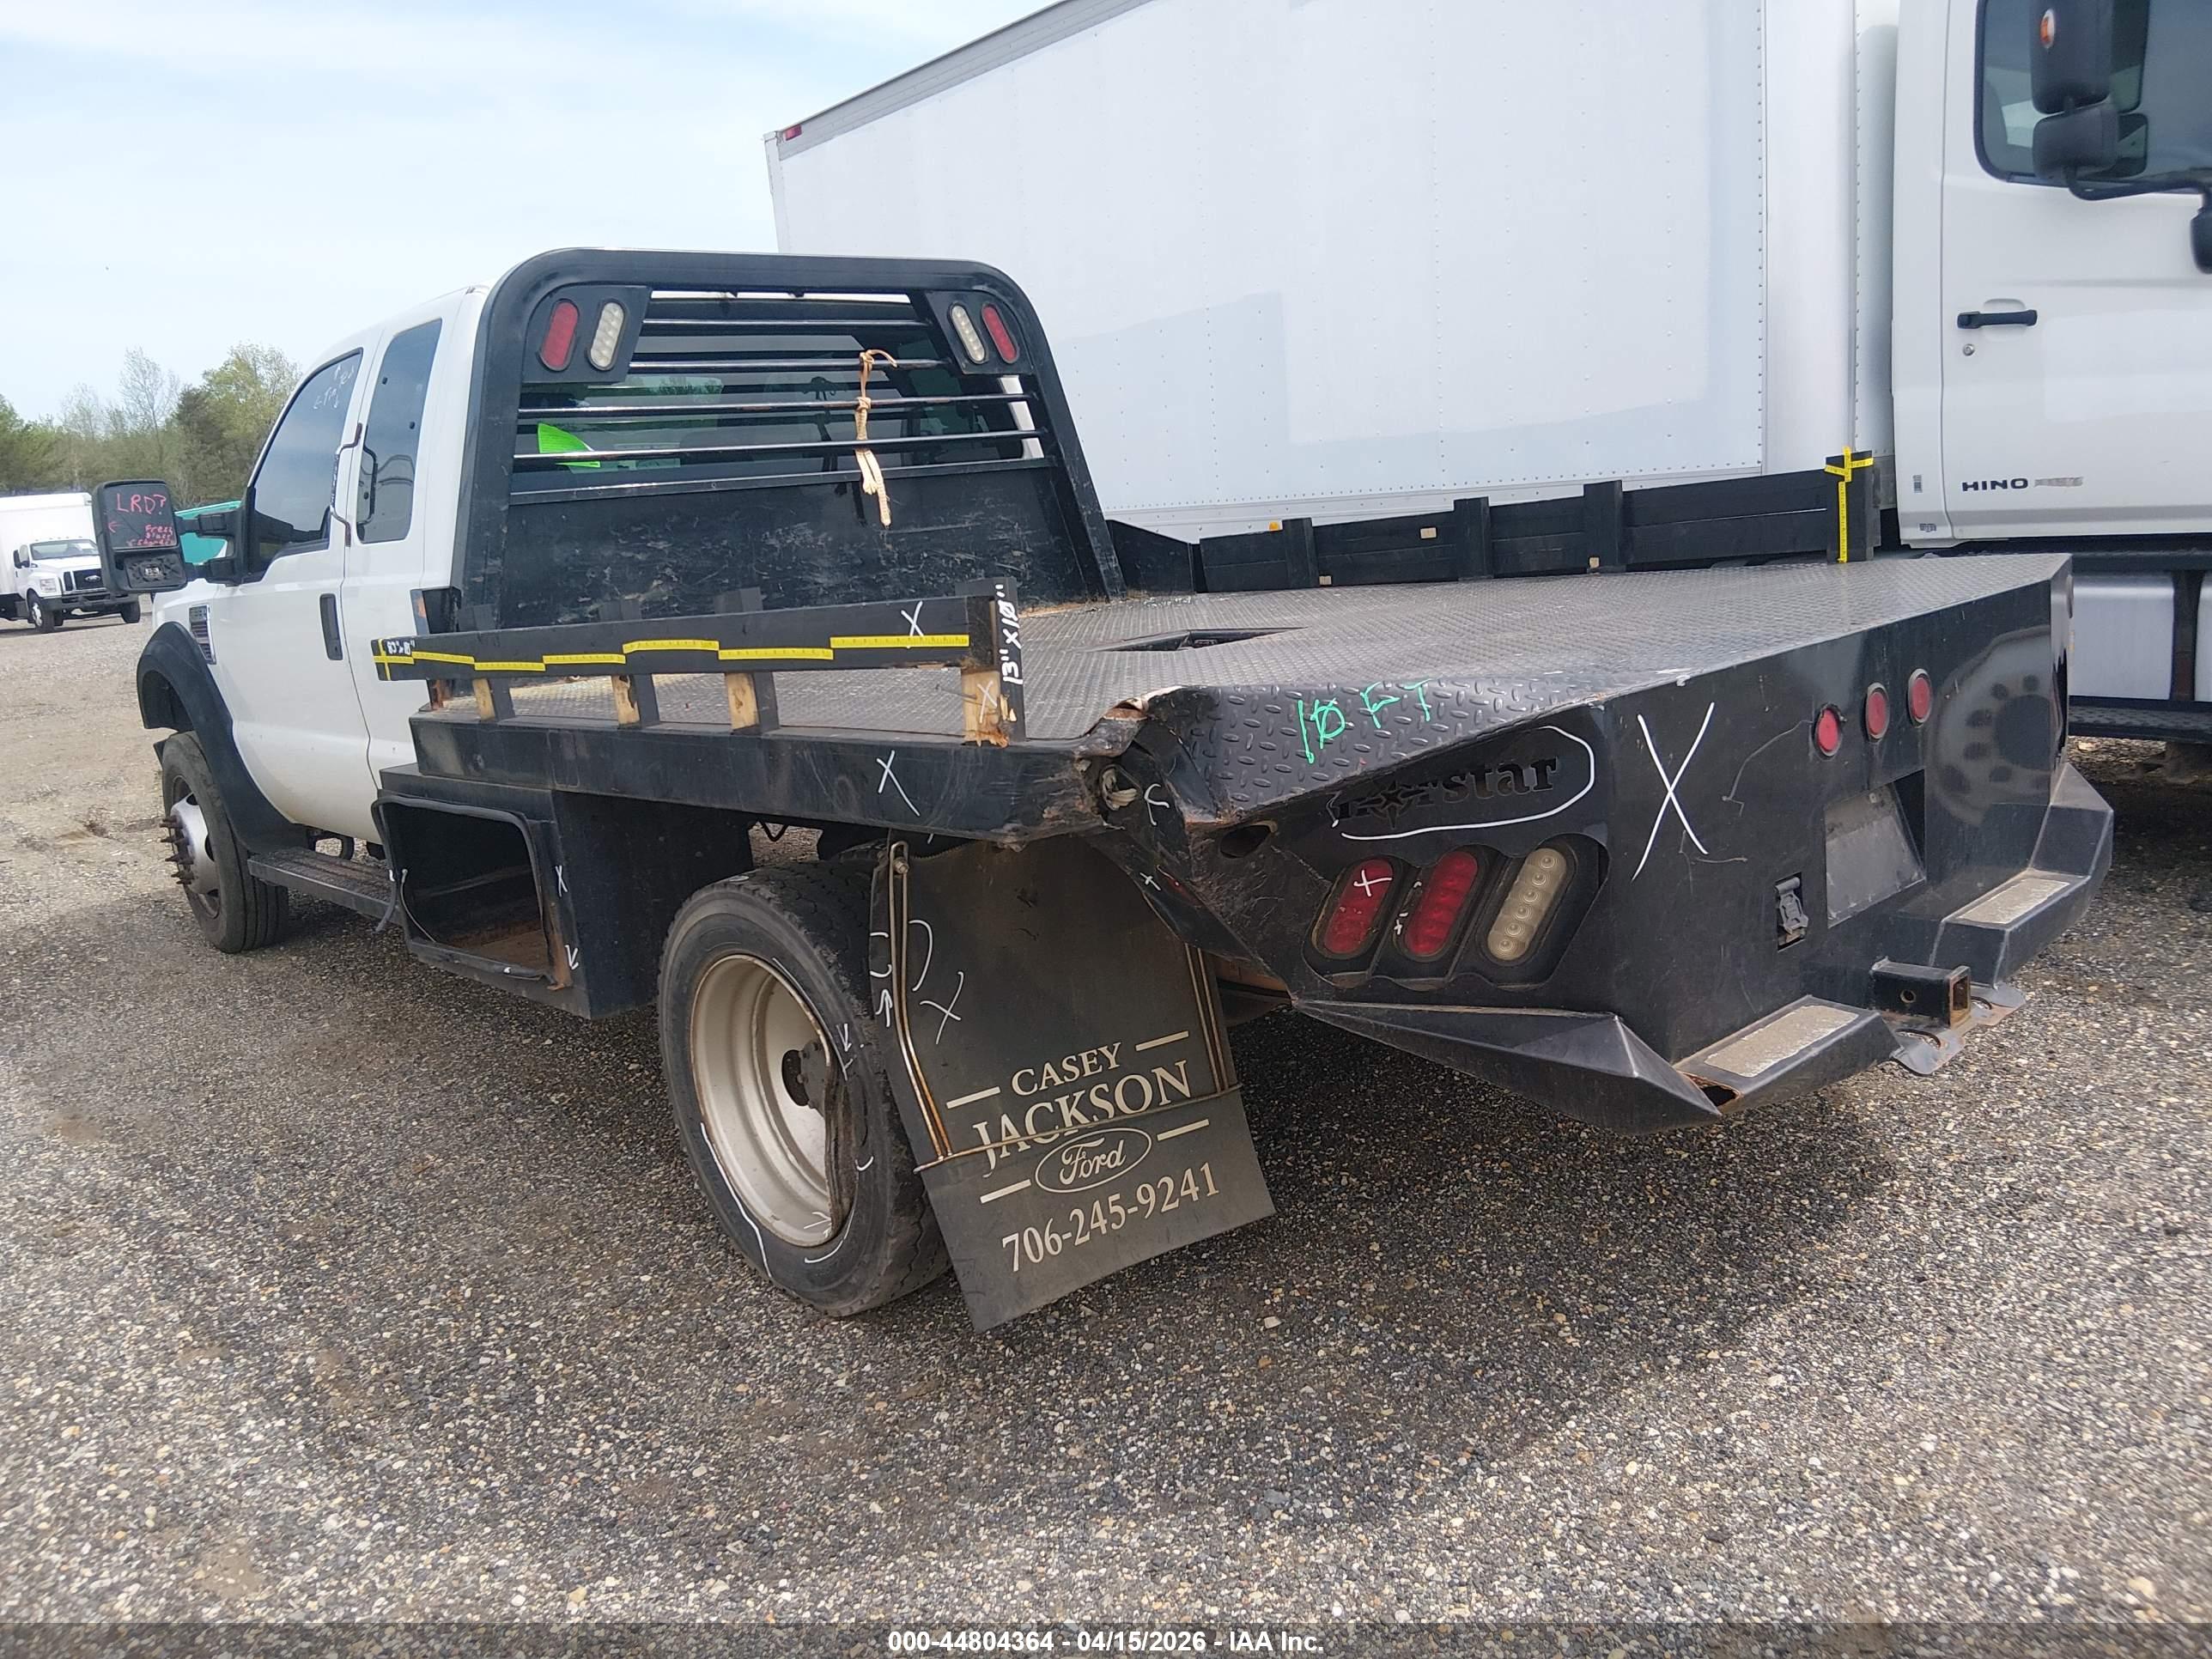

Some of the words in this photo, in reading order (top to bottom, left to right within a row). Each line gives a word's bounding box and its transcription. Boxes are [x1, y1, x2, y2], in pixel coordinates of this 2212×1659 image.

[1962, 477, 2028, 491] HINO
[1012, 1042, 1121, 1097] CASEY
[973, 1060, 1191, 1177] JACKSON
[1059, 1137, 1127, 1185] Ford
[1002, 1162, 1219, 1272] 706-245-9241
